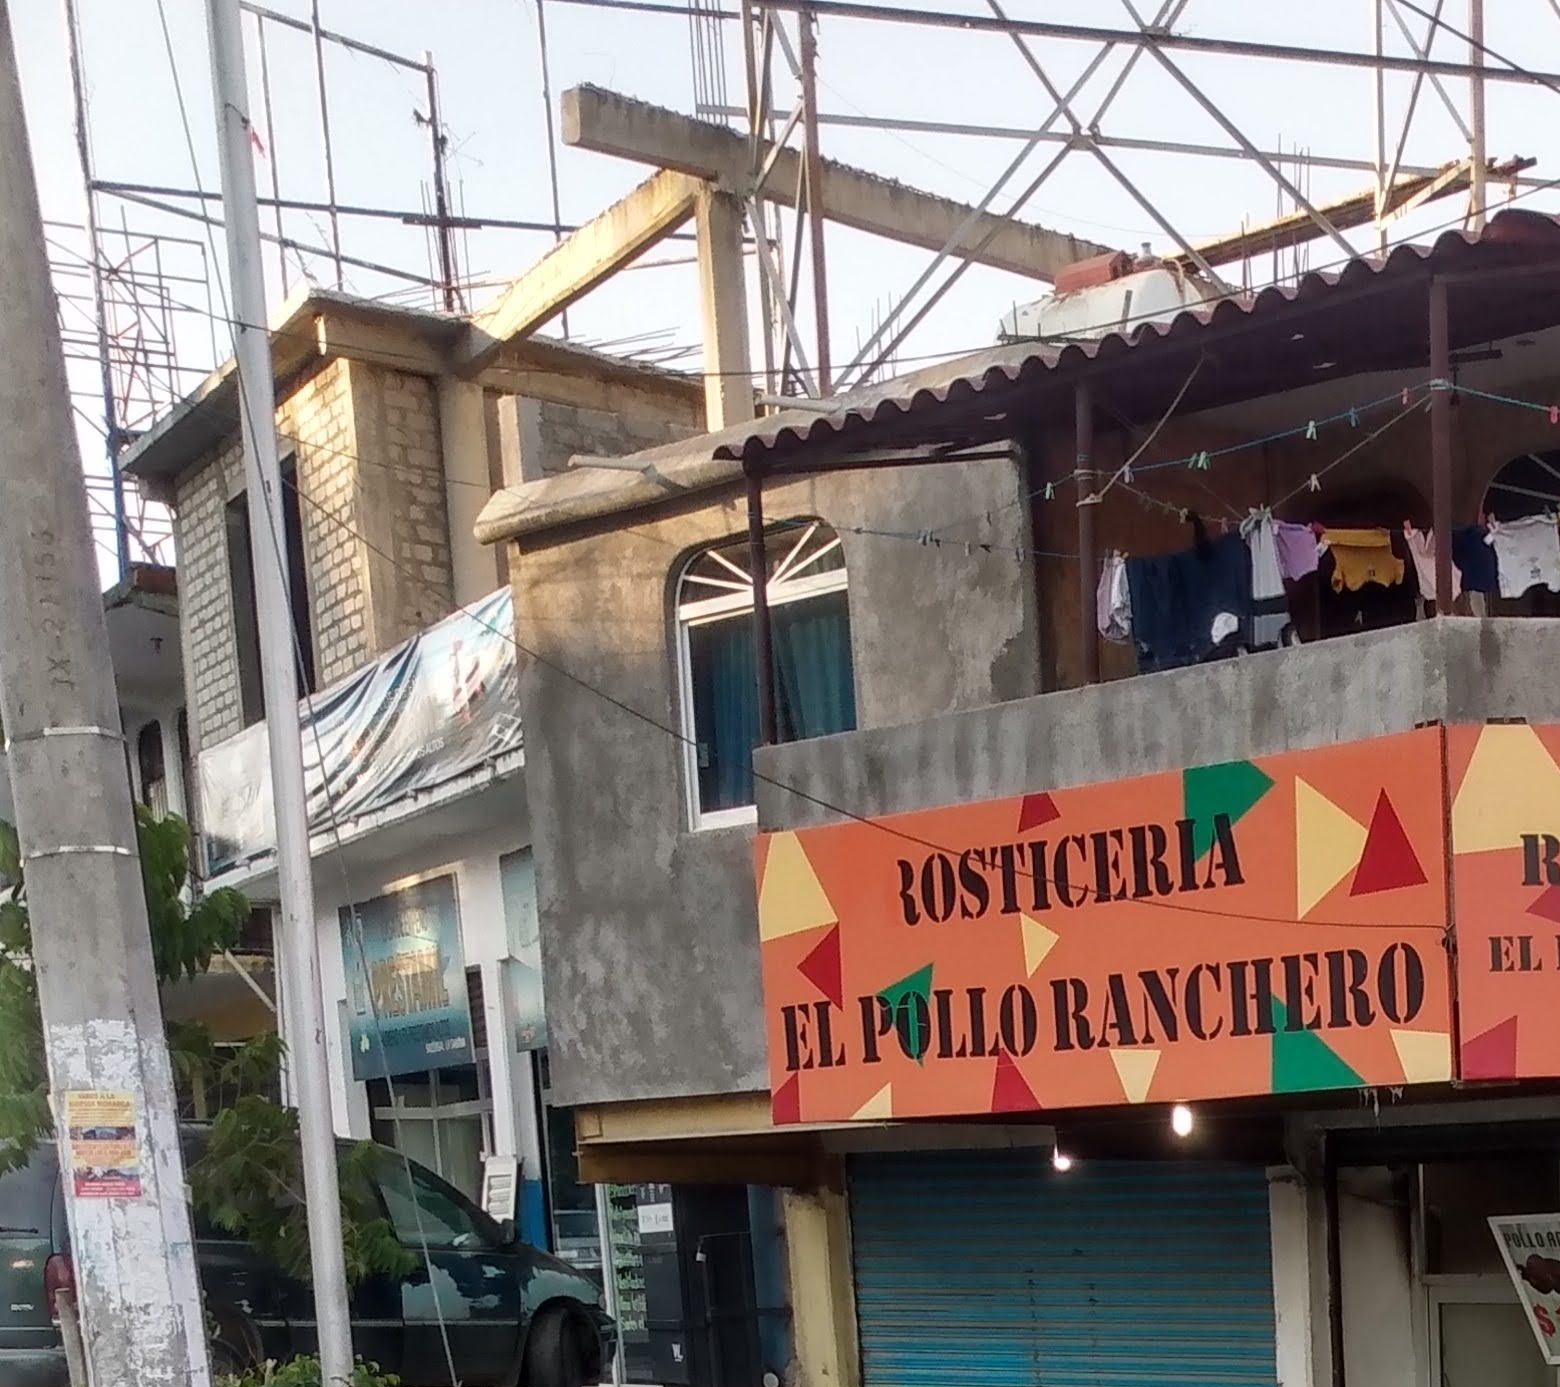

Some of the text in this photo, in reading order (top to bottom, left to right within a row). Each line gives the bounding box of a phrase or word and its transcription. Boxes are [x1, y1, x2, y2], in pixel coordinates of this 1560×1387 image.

[1488, 935, 1543, 973] EL
[781, 940, 1426, 1072] EL POLLO RANCHERO
[1503, 1228, 1546, 1249] POLLO
